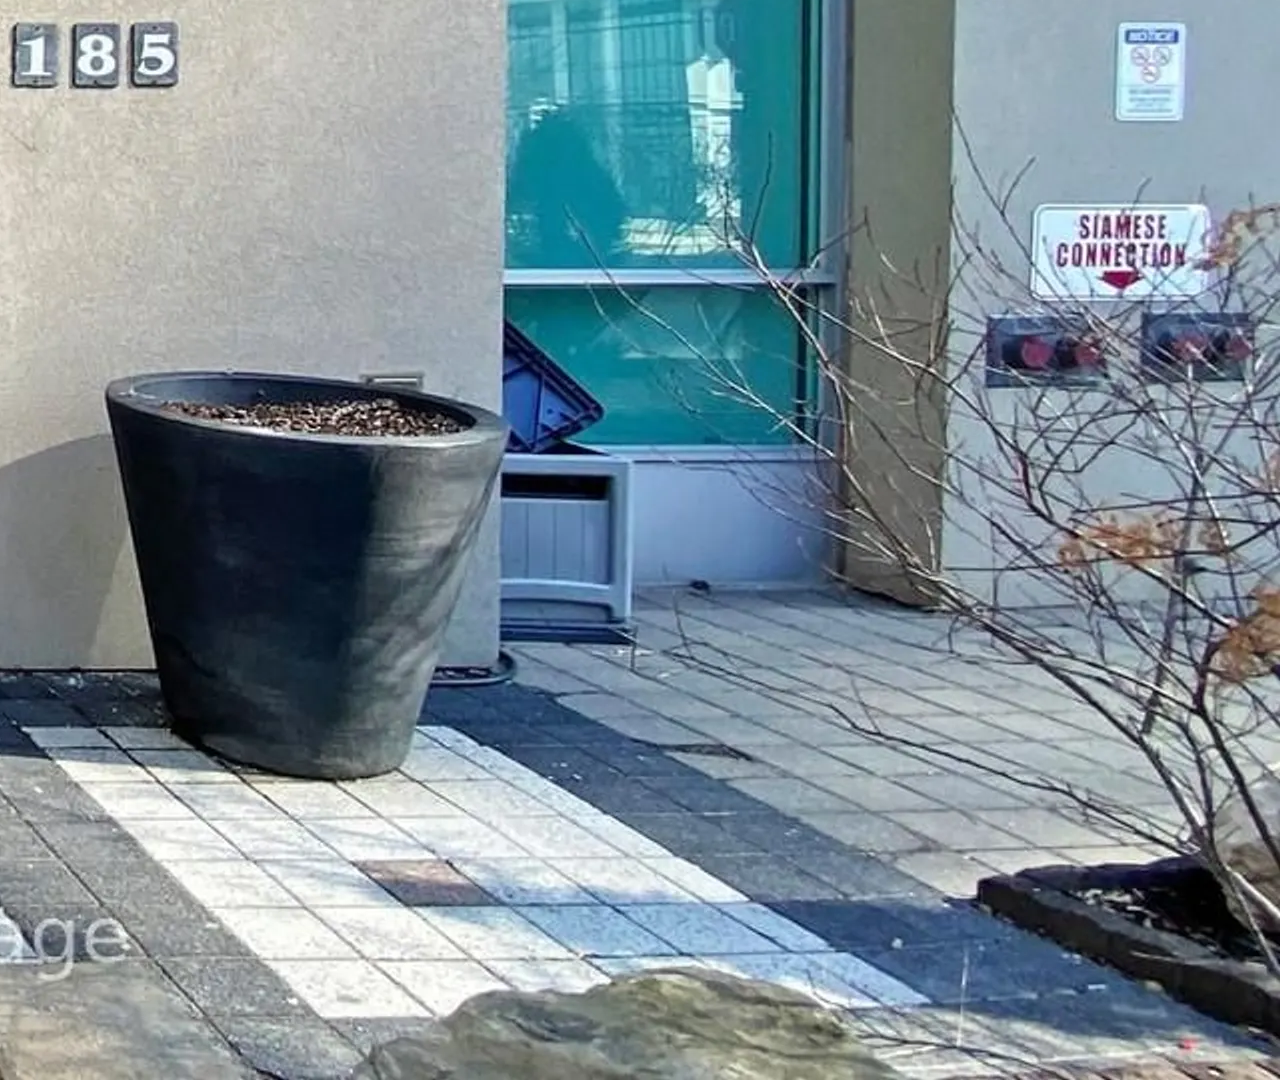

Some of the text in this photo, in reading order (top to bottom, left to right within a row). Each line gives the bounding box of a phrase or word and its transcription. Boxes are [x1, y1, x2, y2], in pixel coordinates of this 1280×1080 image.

[19, 33, 176, 77] 185
[1079, 214, 1167, 240] SIAMESE
[1056, 241, 1187, 268] CONNECTION
